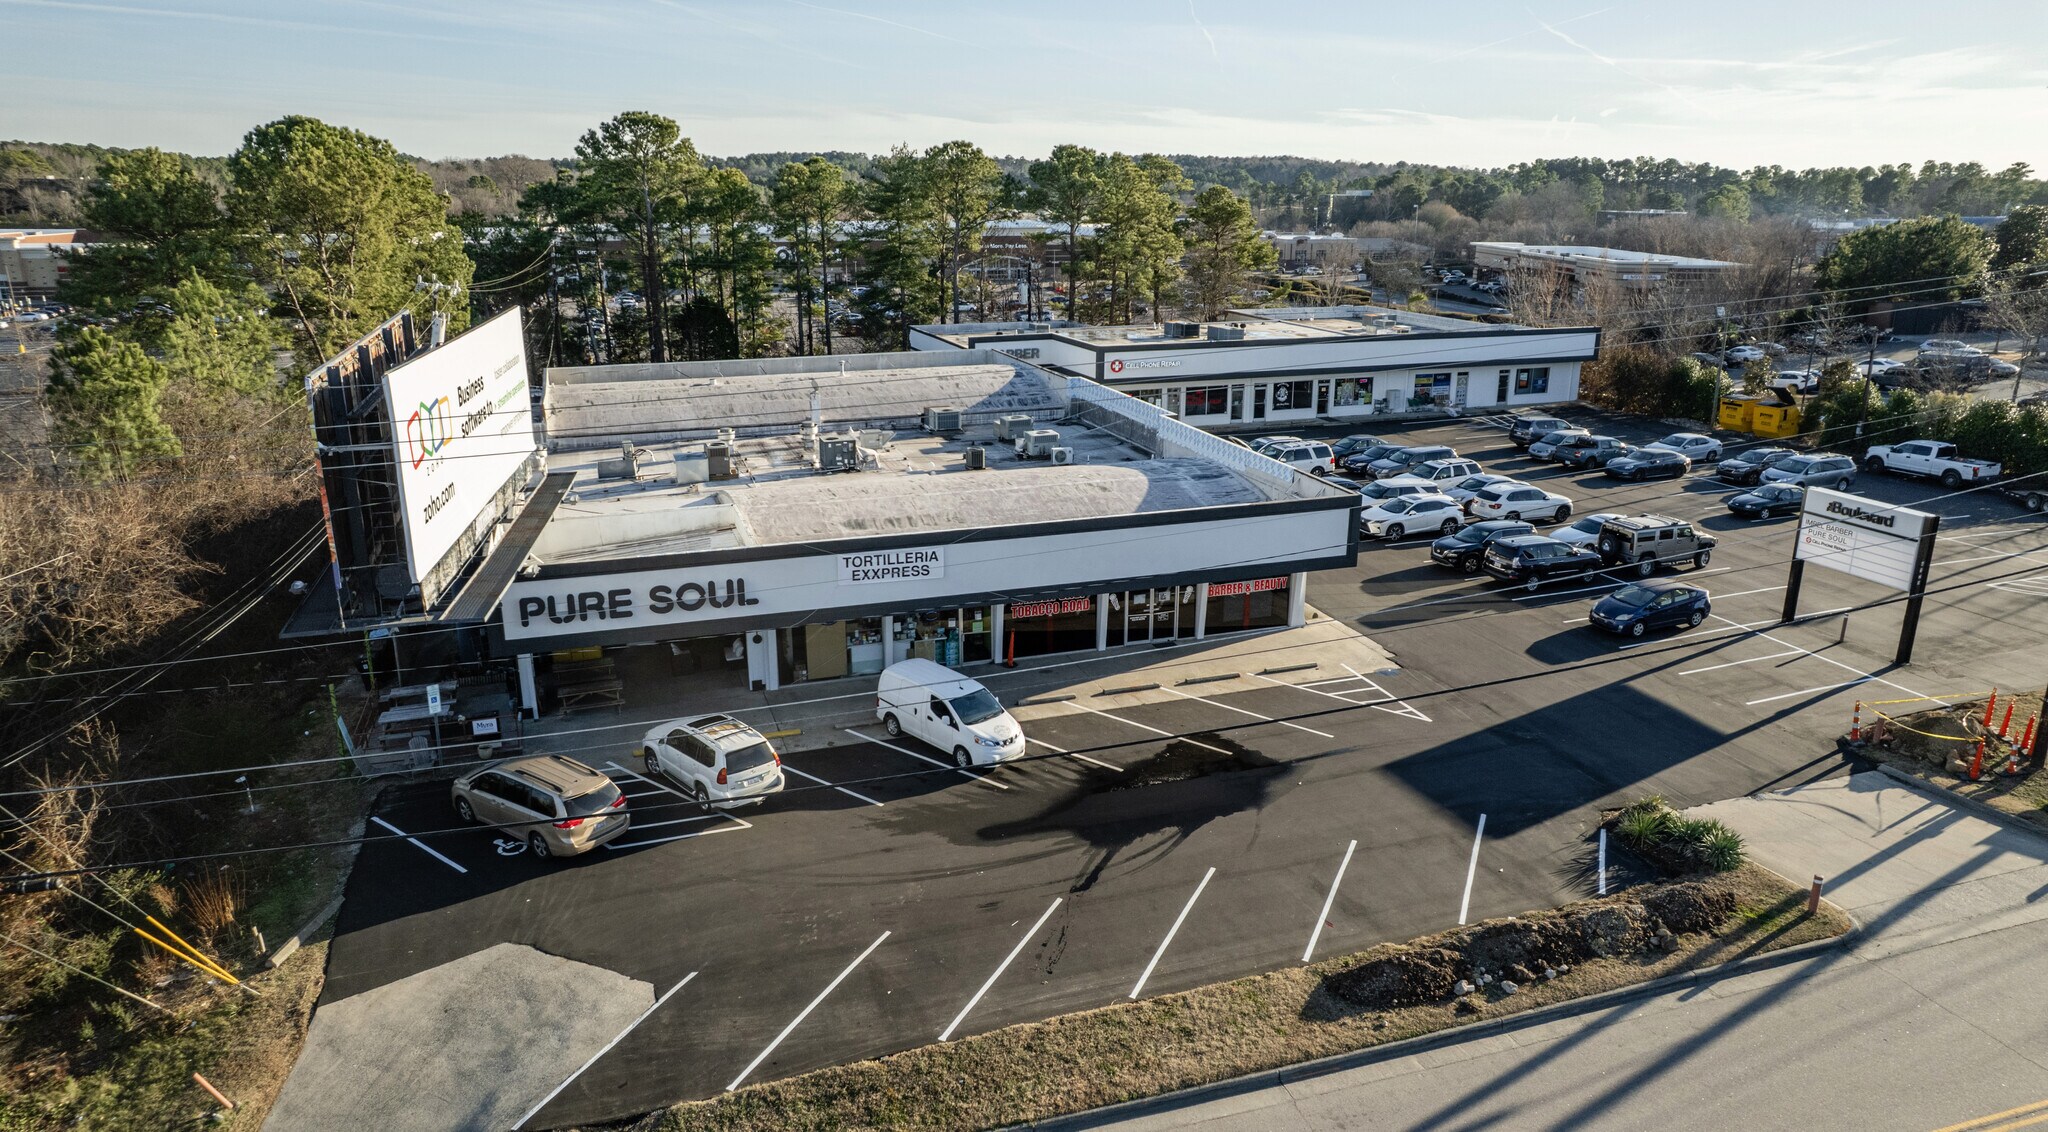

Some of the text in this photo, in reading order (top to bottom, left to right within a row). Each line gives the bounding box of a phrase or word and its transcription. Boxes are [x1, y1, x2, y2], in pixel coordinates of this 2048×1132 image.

[1000, 348, 1040, 359] RBER
[457, 376, 484, 407] Business
[461, 405, 487, 438] software
[486, 399, 493, 416] to
[424, 482, 455, 524] zoho.com
[1831, 501, 1895, 527] Boulevard
[1808, 529, 1847, 544] PURE SOUL
[1826, 525, 1853, 536] BARBER
[843, 551, 939, 568] TORTILLERIA
[852, 565, 930, 581] EXXPRESS
[1208, 577, 1288, 597] BARBER & BEAUTY
[519, 578, 760, 627] PURE SOUL
[1011, 602, 1060, 619] TOBACCO
[1061, 598, 1091, 613] ROAD
